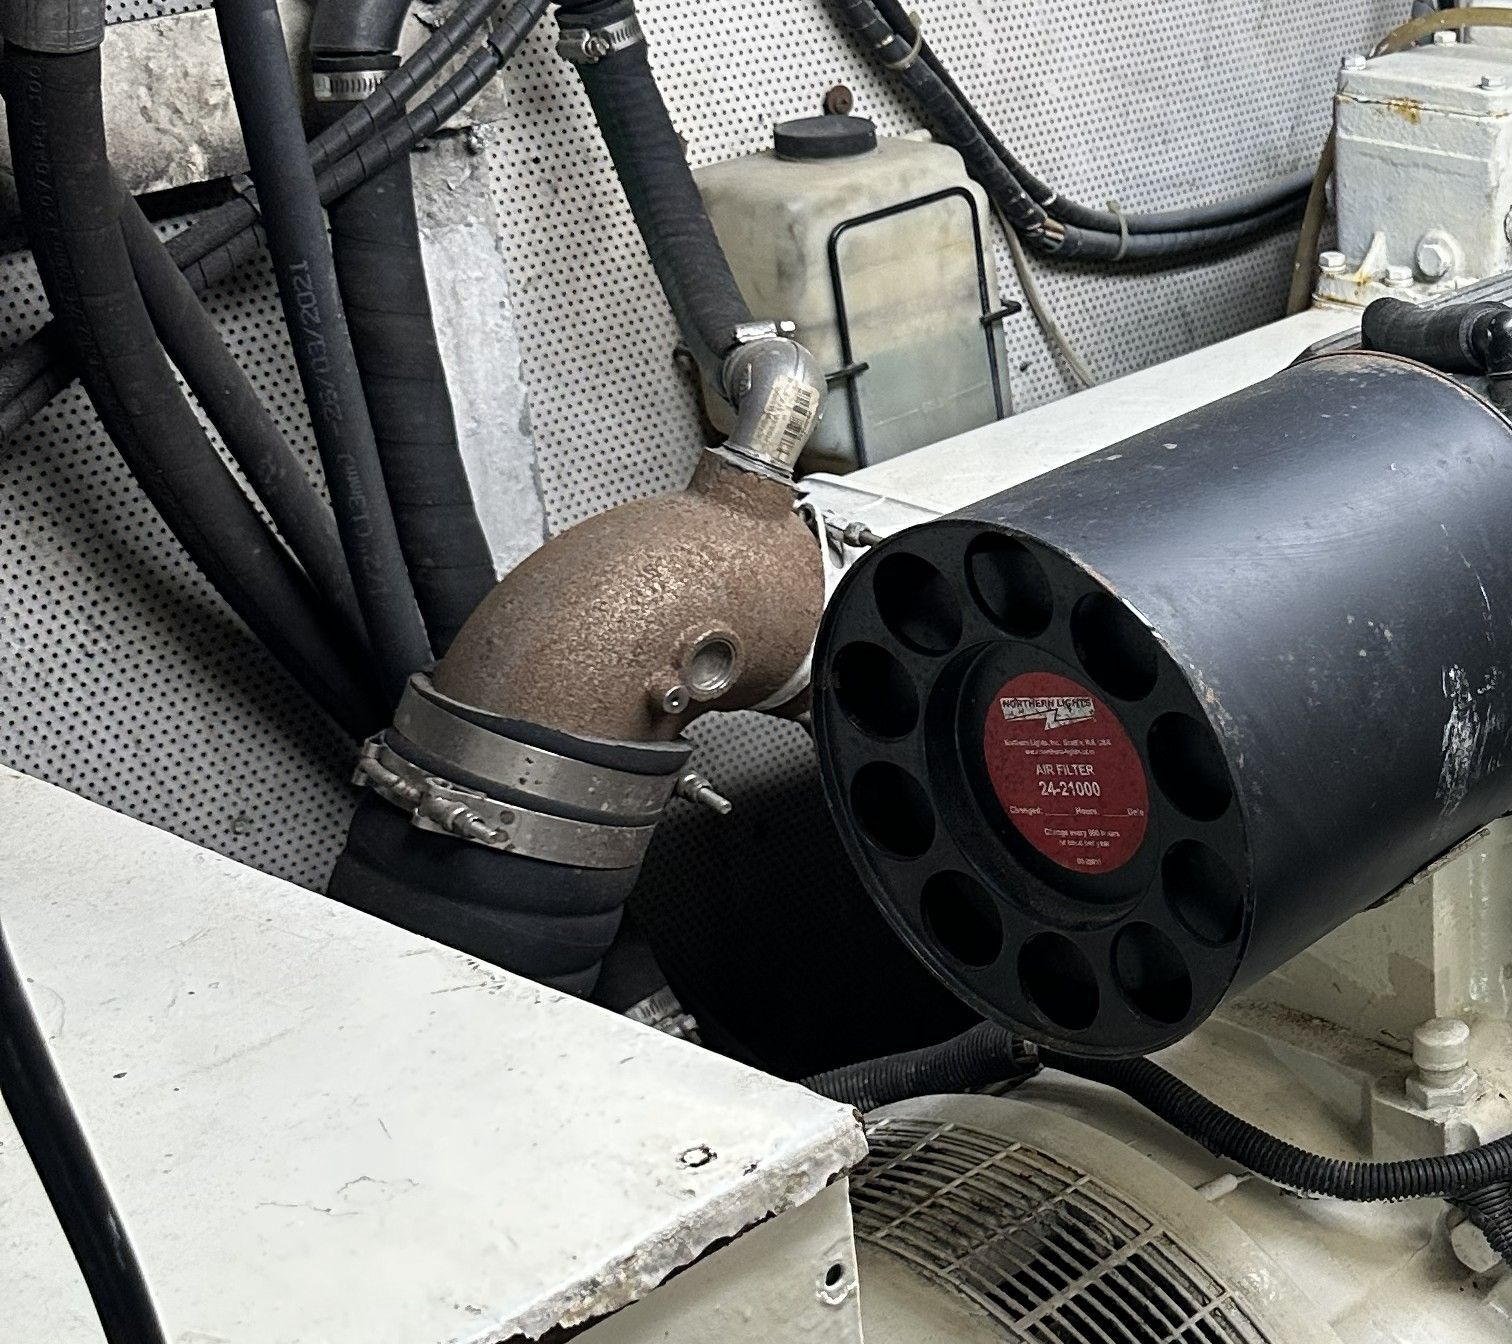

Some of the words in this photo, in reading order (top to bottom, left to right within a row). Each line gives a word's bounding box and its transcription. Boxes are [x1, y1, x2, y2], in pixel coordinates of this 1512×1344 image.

[1002, 698, 1054, 708] NORTHERN
[1057, 698, 1091, 708] LIGHTS
[1036, 764, 1054, 775] AIR
[1056, 764, 1095, 776] FILTER
[1038, 781, 1100, 796] 24-21000
